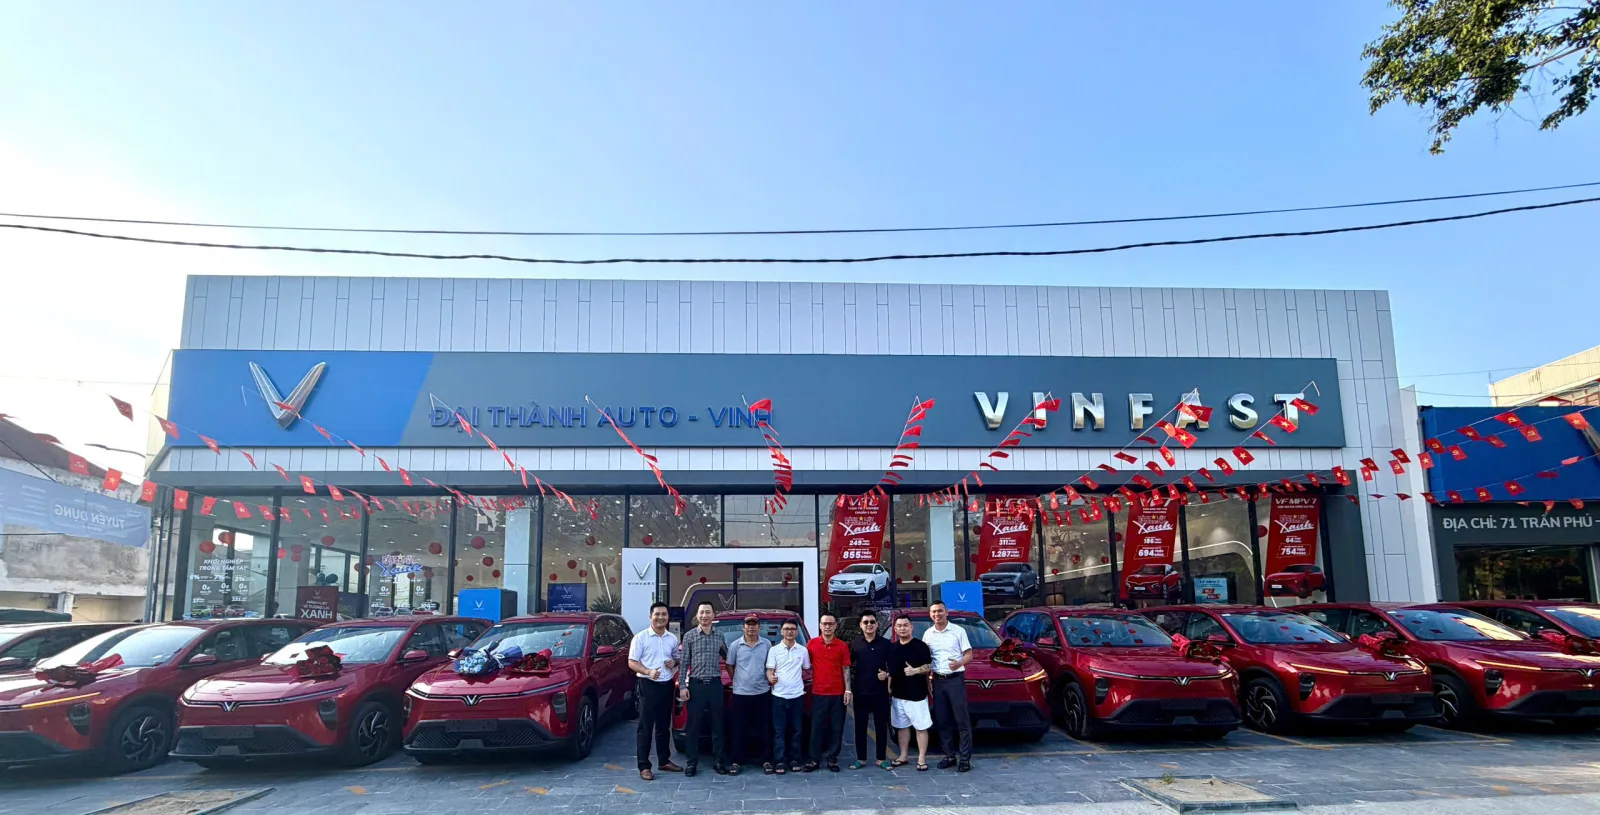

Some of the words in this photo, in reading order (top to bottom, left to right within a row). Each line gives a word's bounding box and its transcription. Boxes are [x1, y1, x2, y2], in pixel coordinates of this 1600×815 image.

[974, 391, 1304, 430] VINFAST
[429, 406, 479, 432] ĐẠI
[487, 401, 588, 428] THÀNH
[597, 406, 678, 428] AUTO
[707, 406, 773, 428] VINH
[1442, 517, 1468, 532] ĐỊA
[1470, 515, 1497, 529] CHỈ:
[1500, 518, 1517, 529] 71
[1520, 511, 1560, 529] TRẦN
[1563, 513, 1593, 528] PHÚ
[843, 550, 861, 559] 855
[992, 550, 1011, 558] 1.287
[1138, 549, 1154, 557] 694
[1281, 548, 1296, 556] 754
[300, 608, 333, 619] XANH
